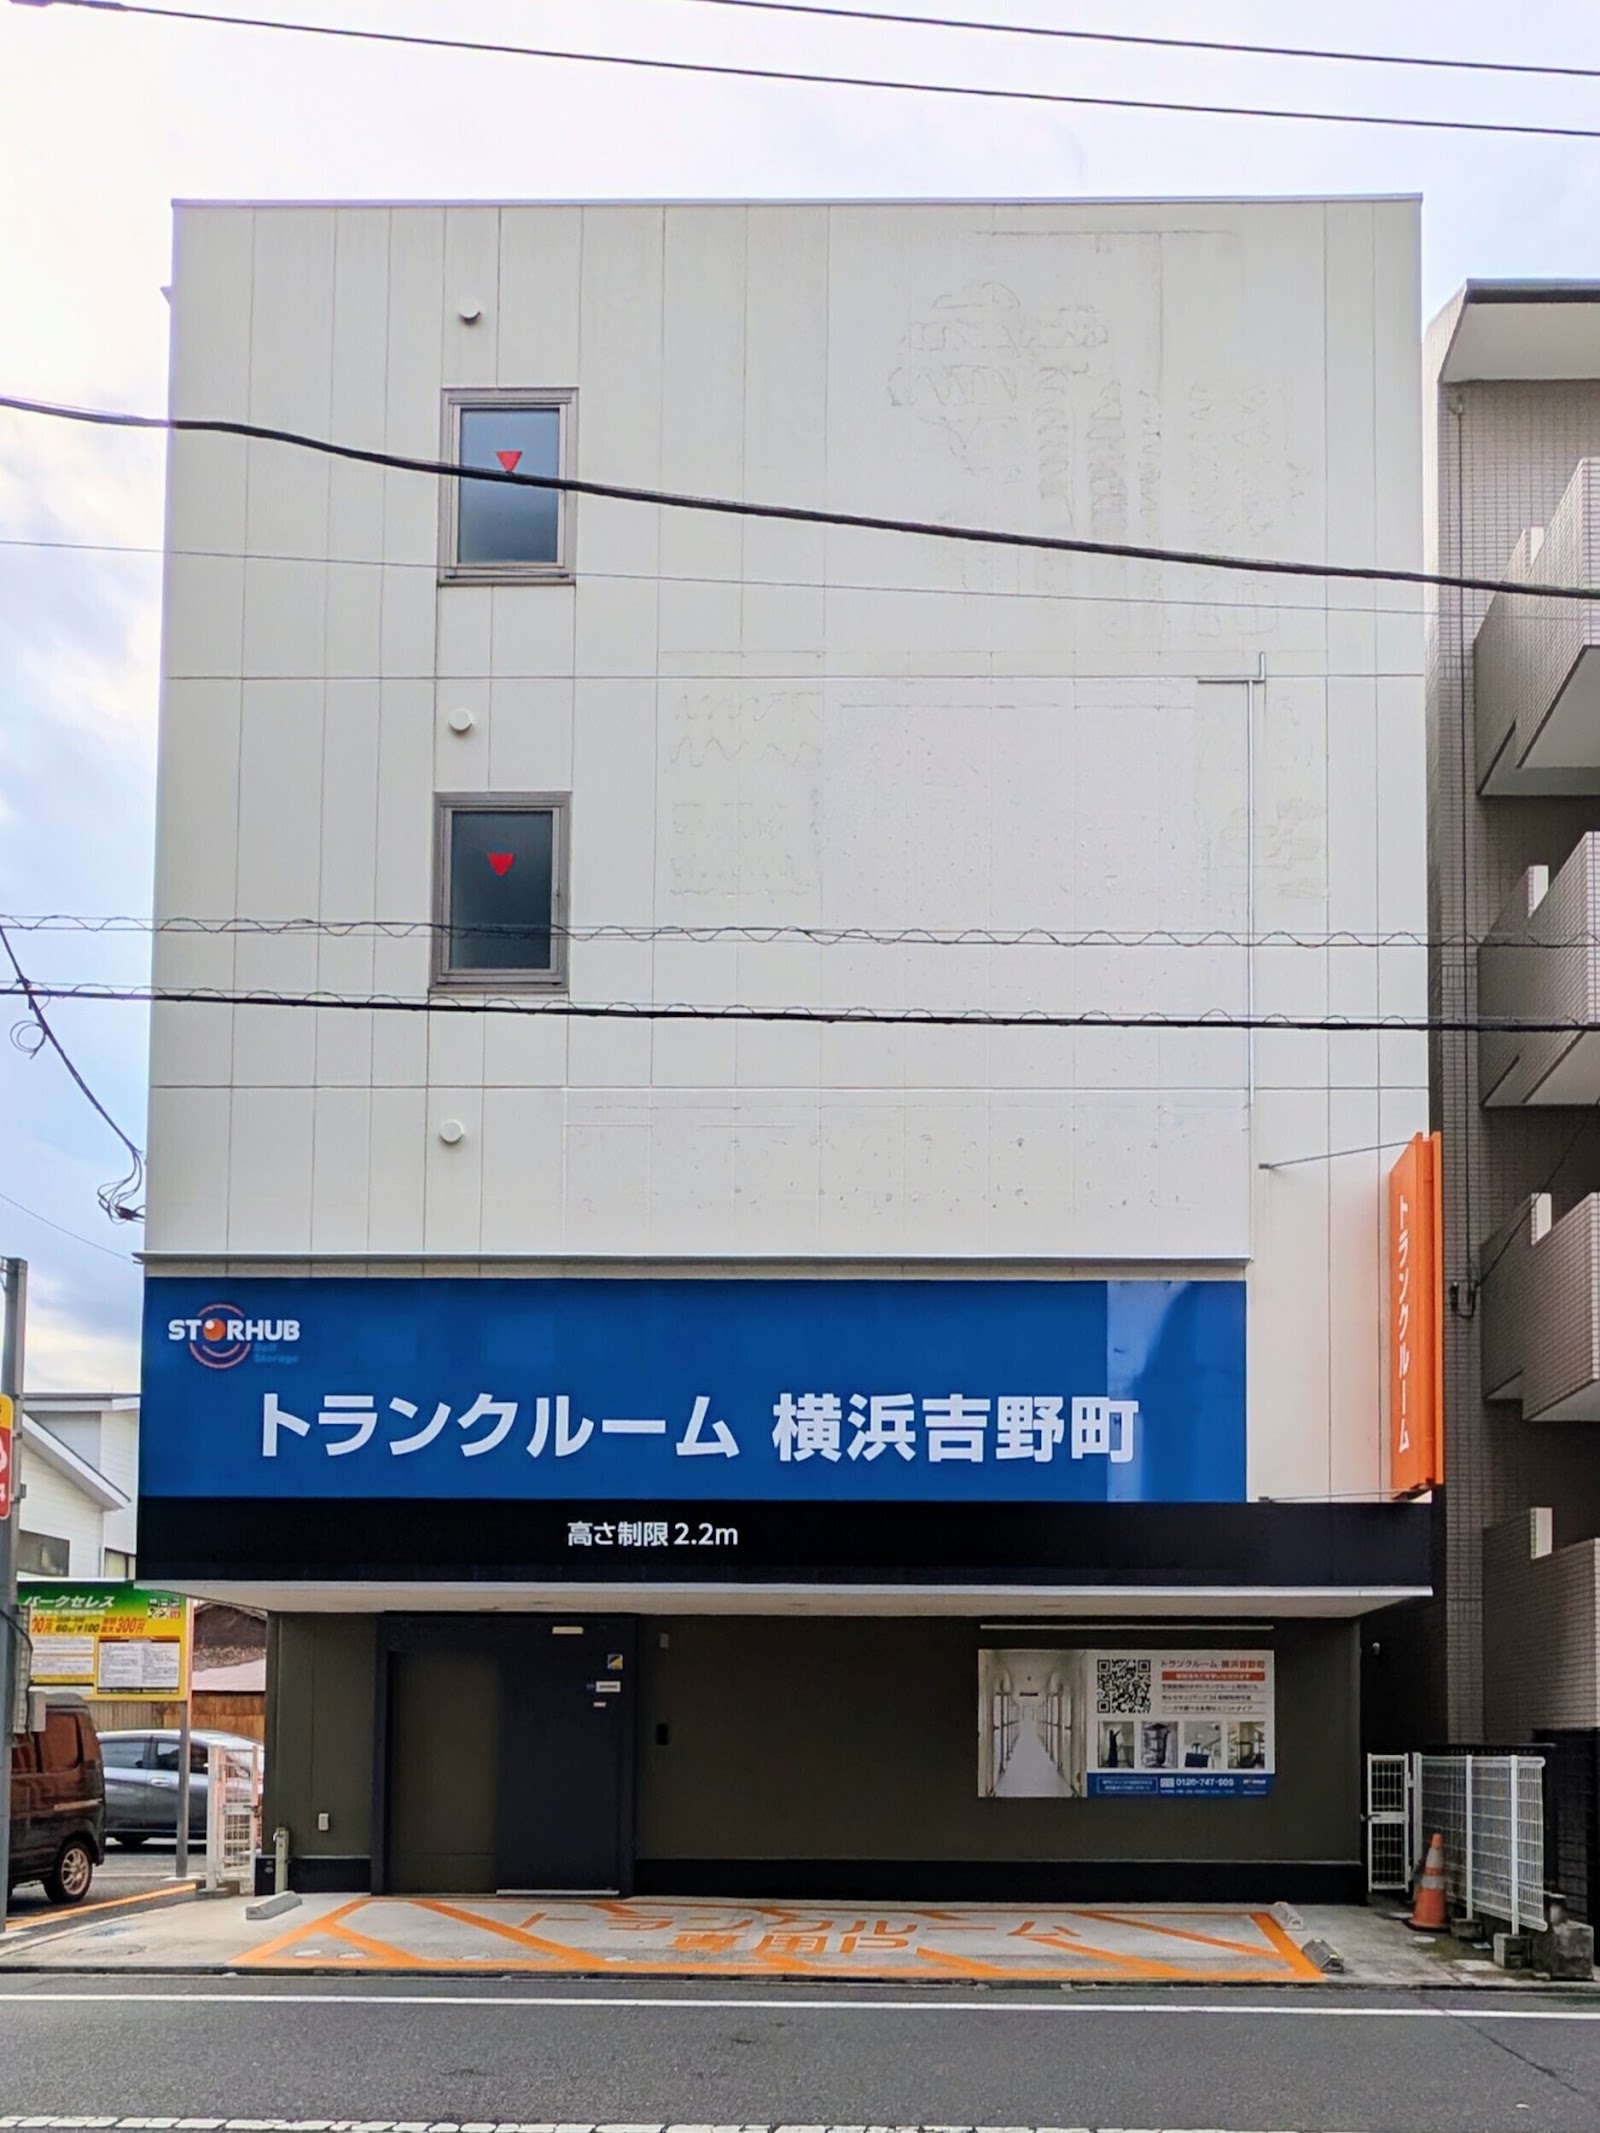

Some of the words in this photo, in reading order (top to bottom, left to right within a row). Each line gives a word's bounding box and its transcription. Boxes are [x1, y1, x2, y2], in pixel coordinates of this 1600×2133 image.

[168, 1319, 300, 1342] STORHUB
[1398, 1195, 1410, 1453] トランクルーム
[261, 1392, 738, 1458] トランクルーム
[772, 1392, 1139, 1464] 横浜吉野町
[1161, 1660, 1217, 1669] トランクルーム
[517, 1910, 1081, 1938] トランクルーム
